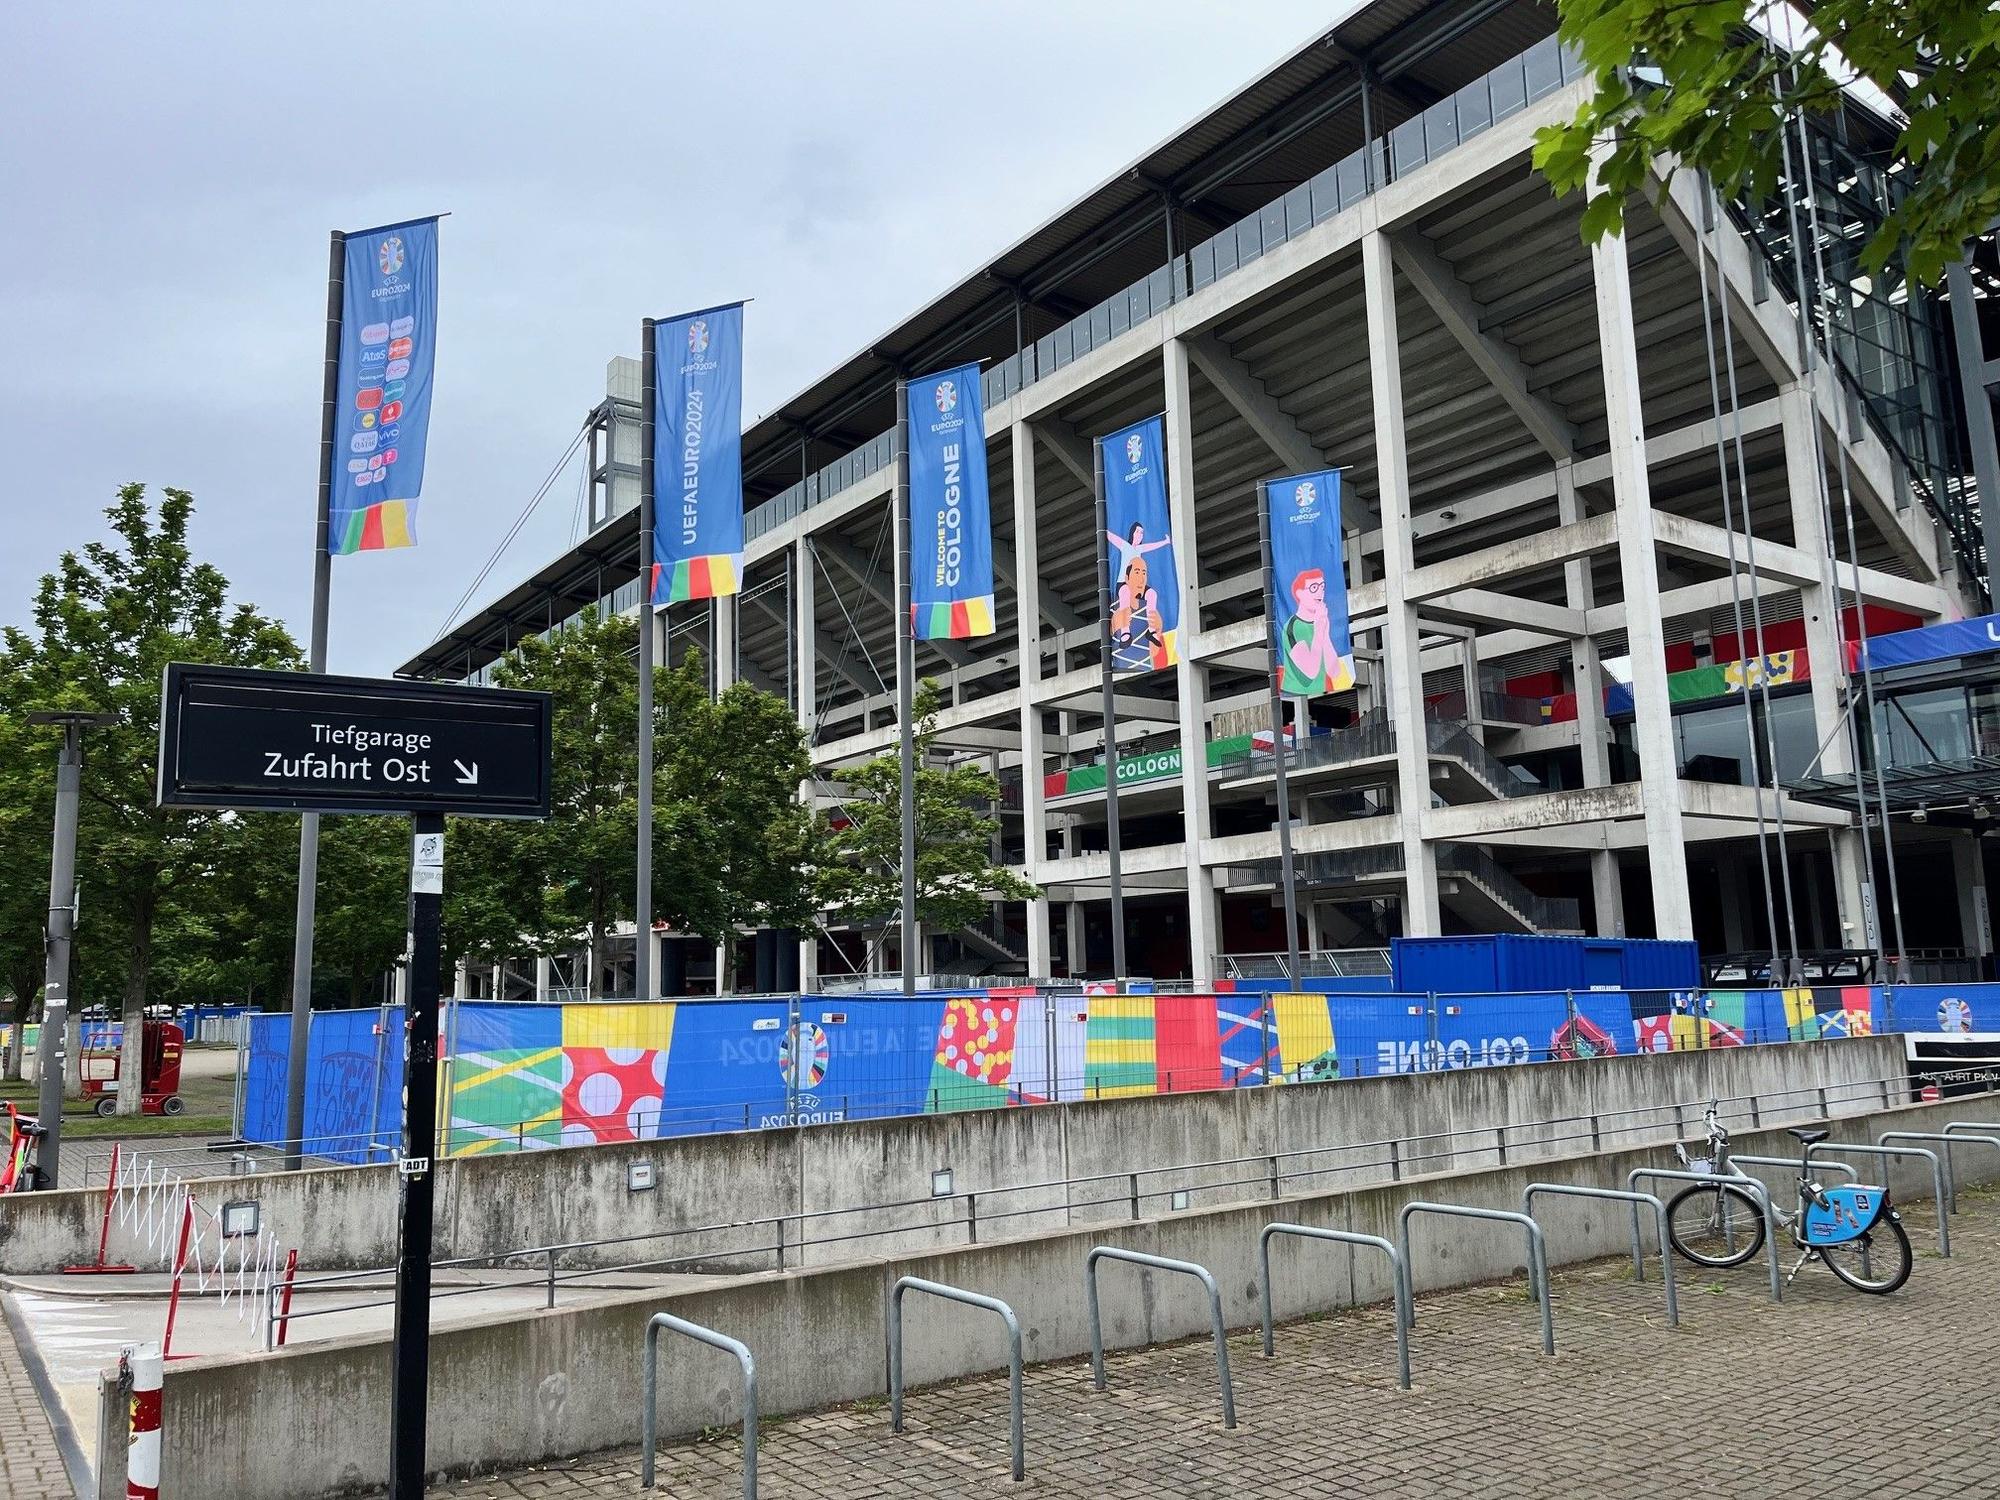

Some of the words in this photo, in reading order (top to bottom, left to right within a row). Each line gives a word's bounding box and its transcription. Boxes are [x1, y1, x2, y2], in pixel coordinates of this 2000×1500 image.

[938, 510, 946, 528] TO
[943, 443, 961, 588] COLOGNE
[935, 529, 946, 588] WELCOME
[311, 724, 432, 753] Tiefgarage
[263, 752, 372, 781] Zufahrt
[383, 758, 432, 784] Ost
[1116, 754, 1180, 778] COLOGN
